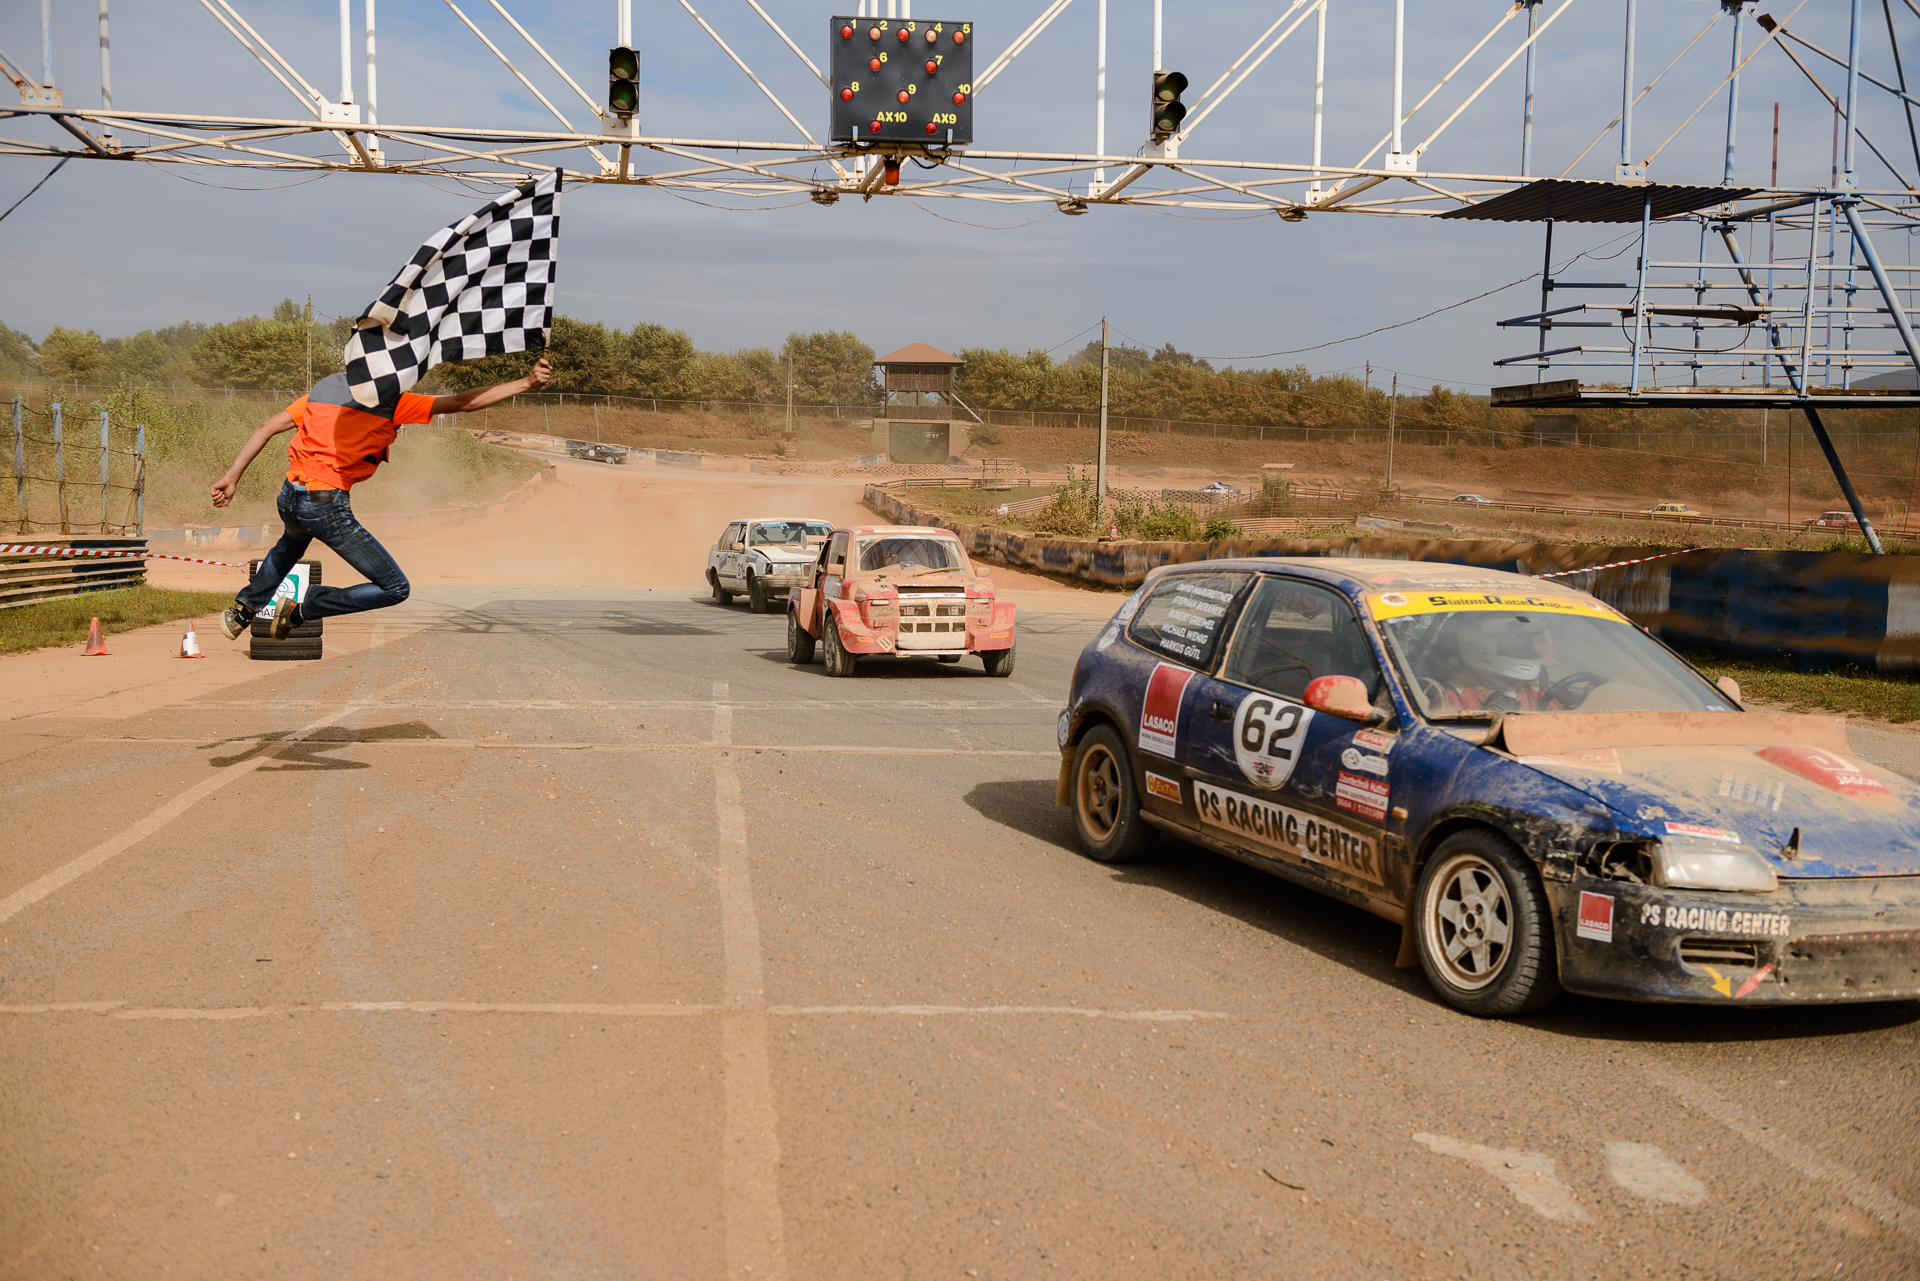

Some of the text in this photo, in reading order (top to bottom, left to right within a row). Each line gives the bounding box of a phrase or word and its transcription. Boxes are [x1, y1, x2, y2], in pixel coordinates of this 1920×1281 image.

[851, 19, 970, 34] 1 2 3 4 5
[879, 52, 943, 66] 6 7
[851, 81, 971, 95] 8 9 10
[876, 111, 957, 124] AX10 AX9
[1168, 609, 1191, 622] ROBERT
[1161, 622, 1209, 645] MICHAEL WENIG
[1159, 638, 1202, 660] MARKUS GÜTL
[1143, 713, 1175, 734] LASACO
[1241, 699, 1303, 760] 62
[1360, 732, 1386, 746] SPAR
[1199, 788, 1376, 877] PS RACING CENTER
[1677, 824, 1722, 836] SPAR
[1580, 919, 1609, 931] LASACO
[1640, 903, 1791, 936] PS RACING CENTER
